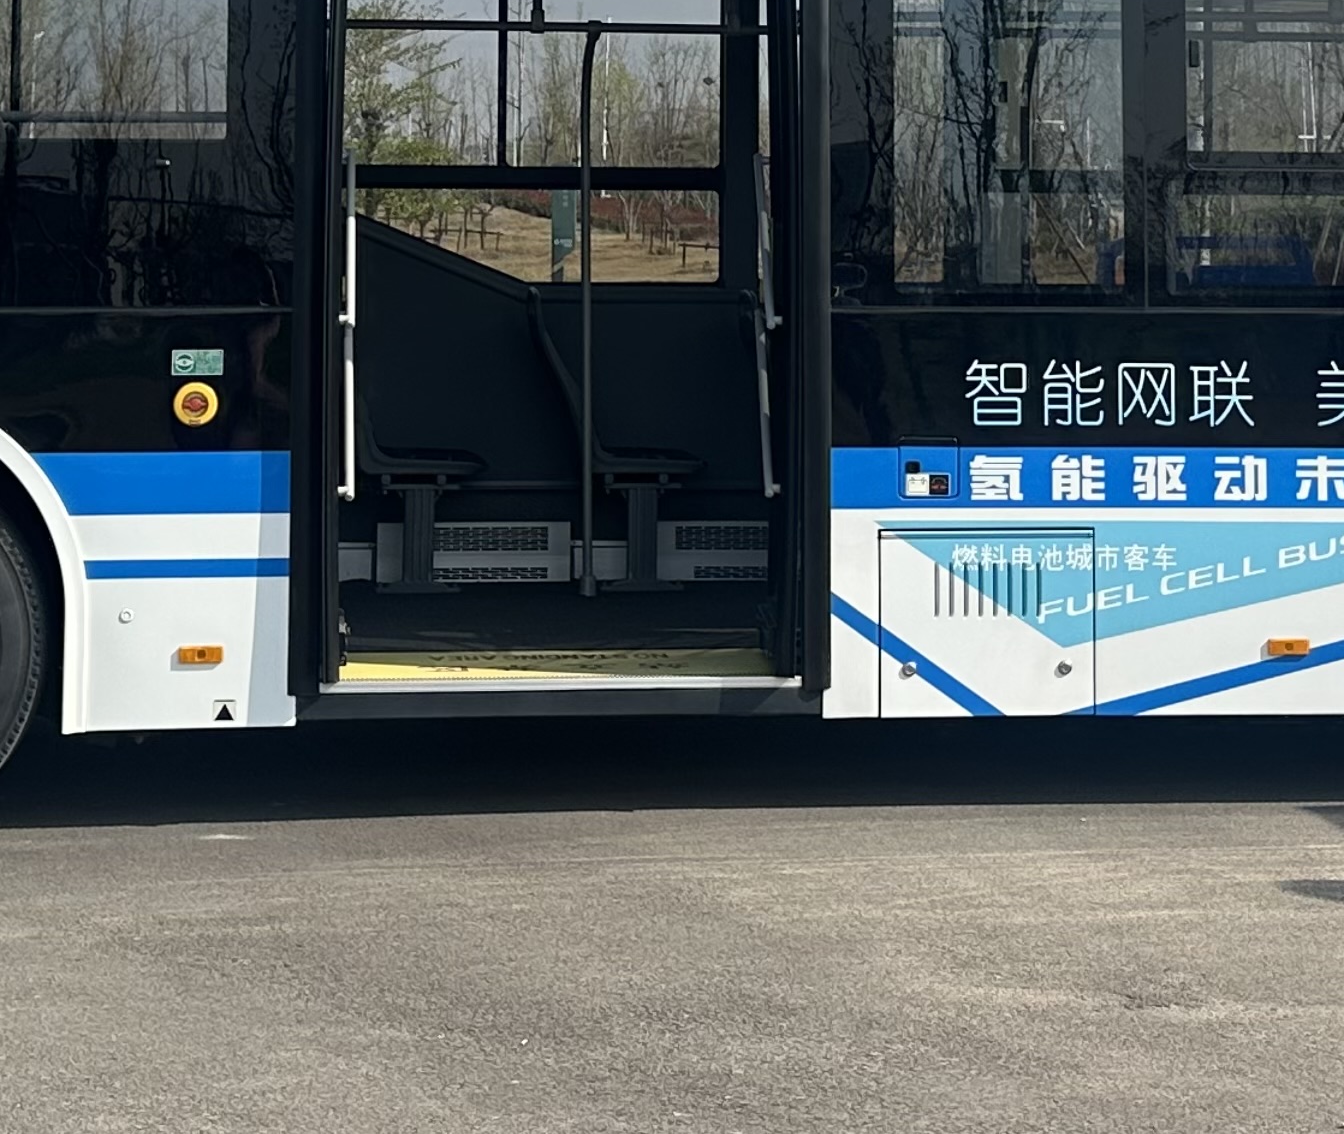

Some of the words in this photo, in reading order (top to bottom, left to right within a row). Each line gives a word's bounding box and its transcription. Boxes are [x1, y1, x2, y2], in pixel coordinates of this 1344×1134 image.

[964, 358, 1256, 428] 智能网联
[951, 542, 1178, 573] 燃料电池城市客车
[1036, 582, 1150, 625] FUEL
[1159, 555, 1267, 598] CELL
